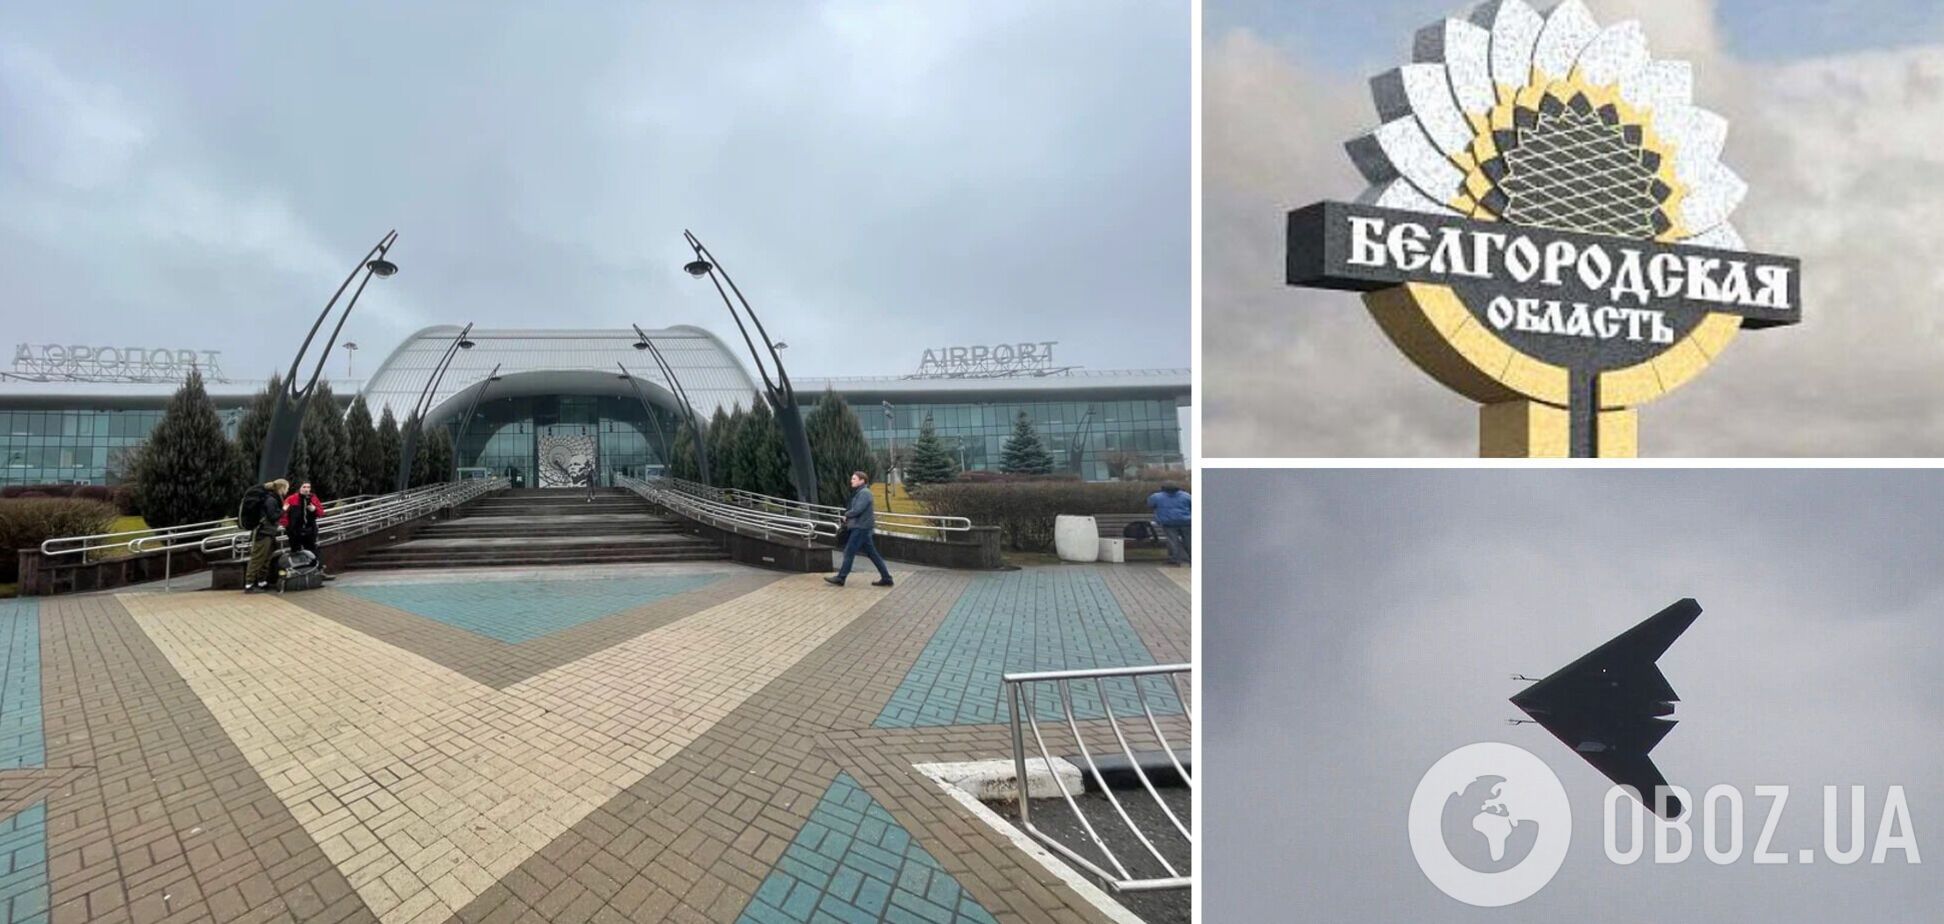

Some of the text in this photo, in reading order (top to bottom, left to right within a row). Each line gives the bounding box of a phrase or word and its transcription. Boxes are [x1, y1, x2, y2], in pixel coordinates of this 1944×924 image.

[1347, 216, 1791, 309] БЕЛГОРОДСКАЯ
[1486, 296, 1675, 344] ОБЛАСТЬ
[12, 343, 221, 371] АЭРОПОРТ
[921, 341, 1058, 367] AIRPORT
